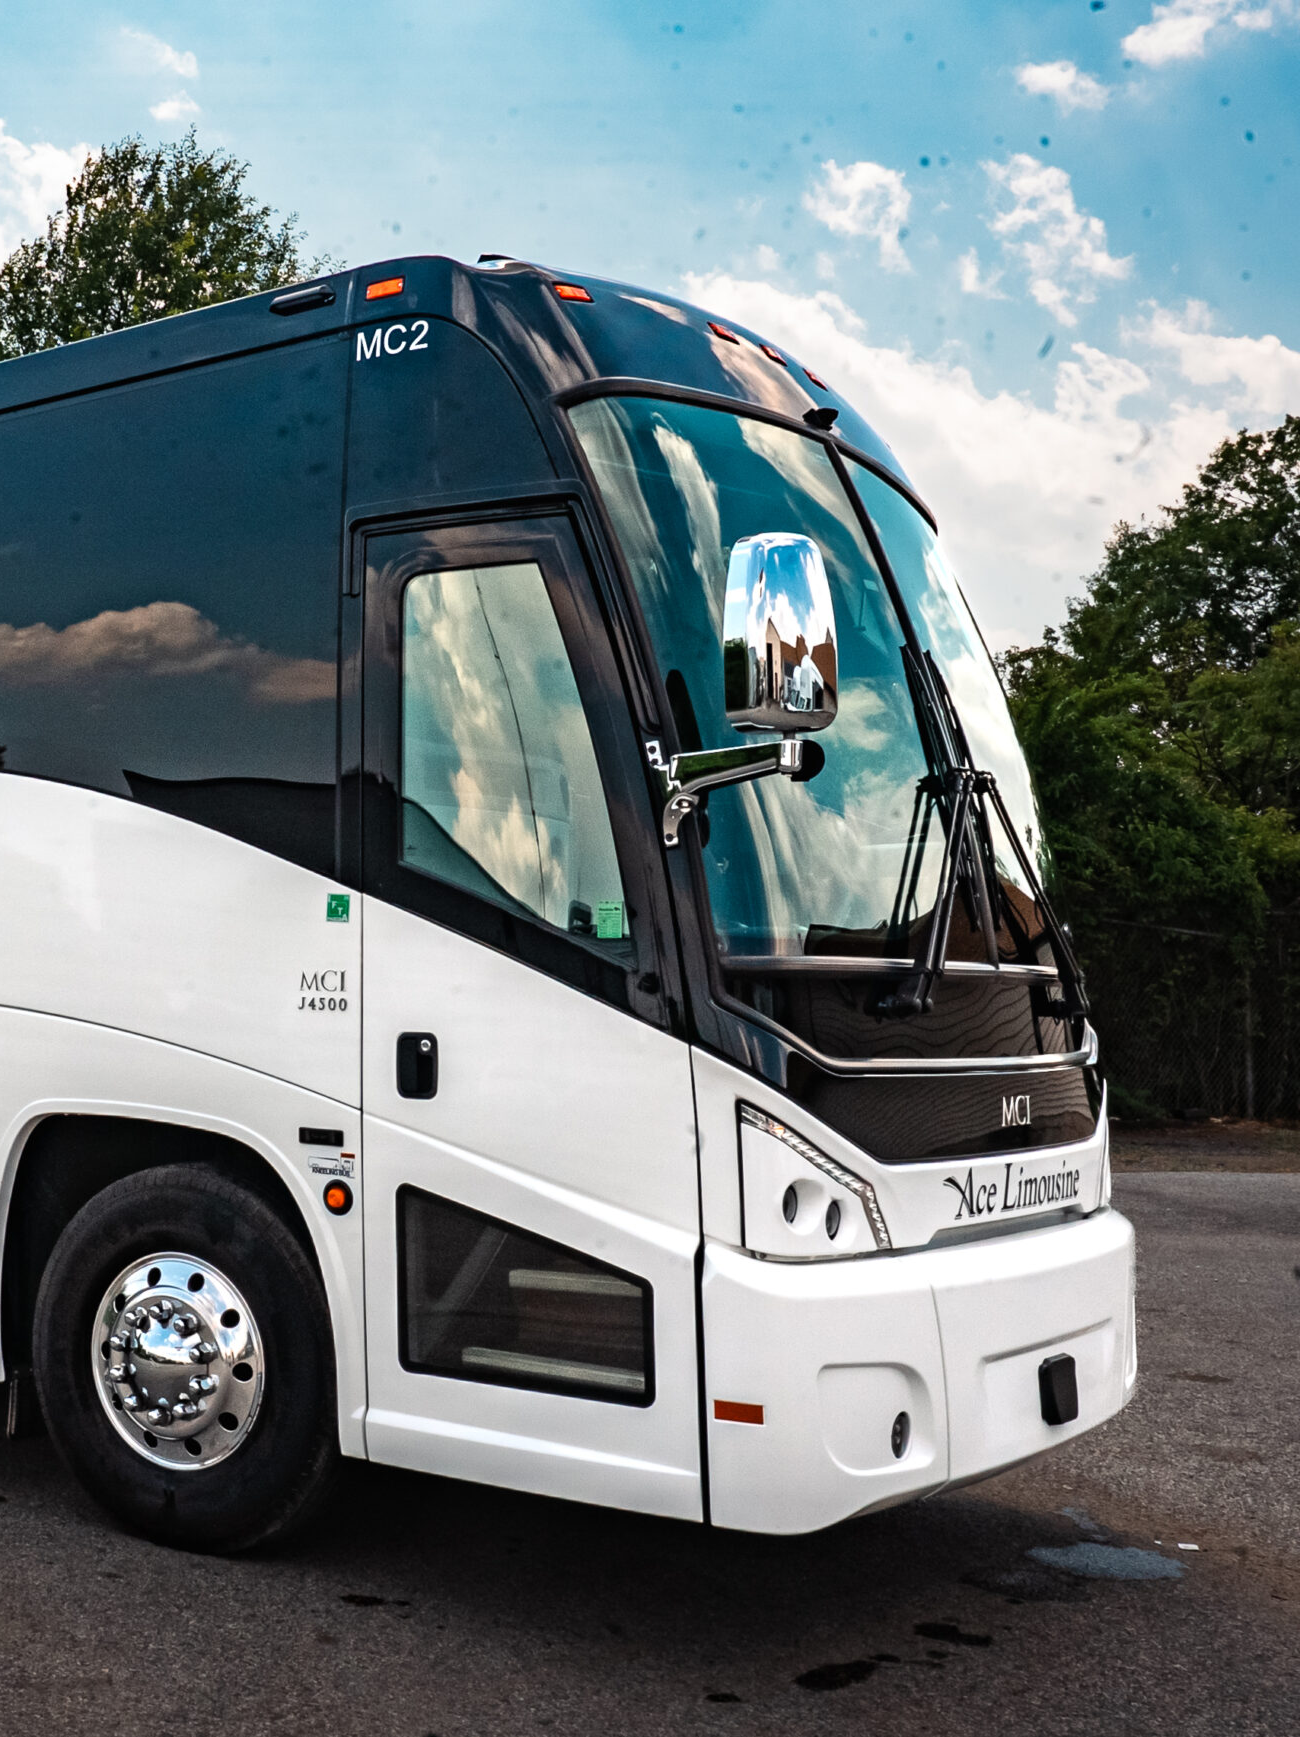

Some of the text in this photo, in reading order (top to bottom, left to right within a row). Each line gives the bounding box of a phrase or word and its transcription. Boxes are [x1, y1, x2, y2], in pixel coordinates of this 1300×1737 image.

[356, 320, 429, 362] MC2
[300, 970, 346, 992] MCI
[298, 996, 348, 1012] J4500
[1001, 1095, 1032, 1127] MCI
[943, 1159, 1081, 1220] Ace Limousine
